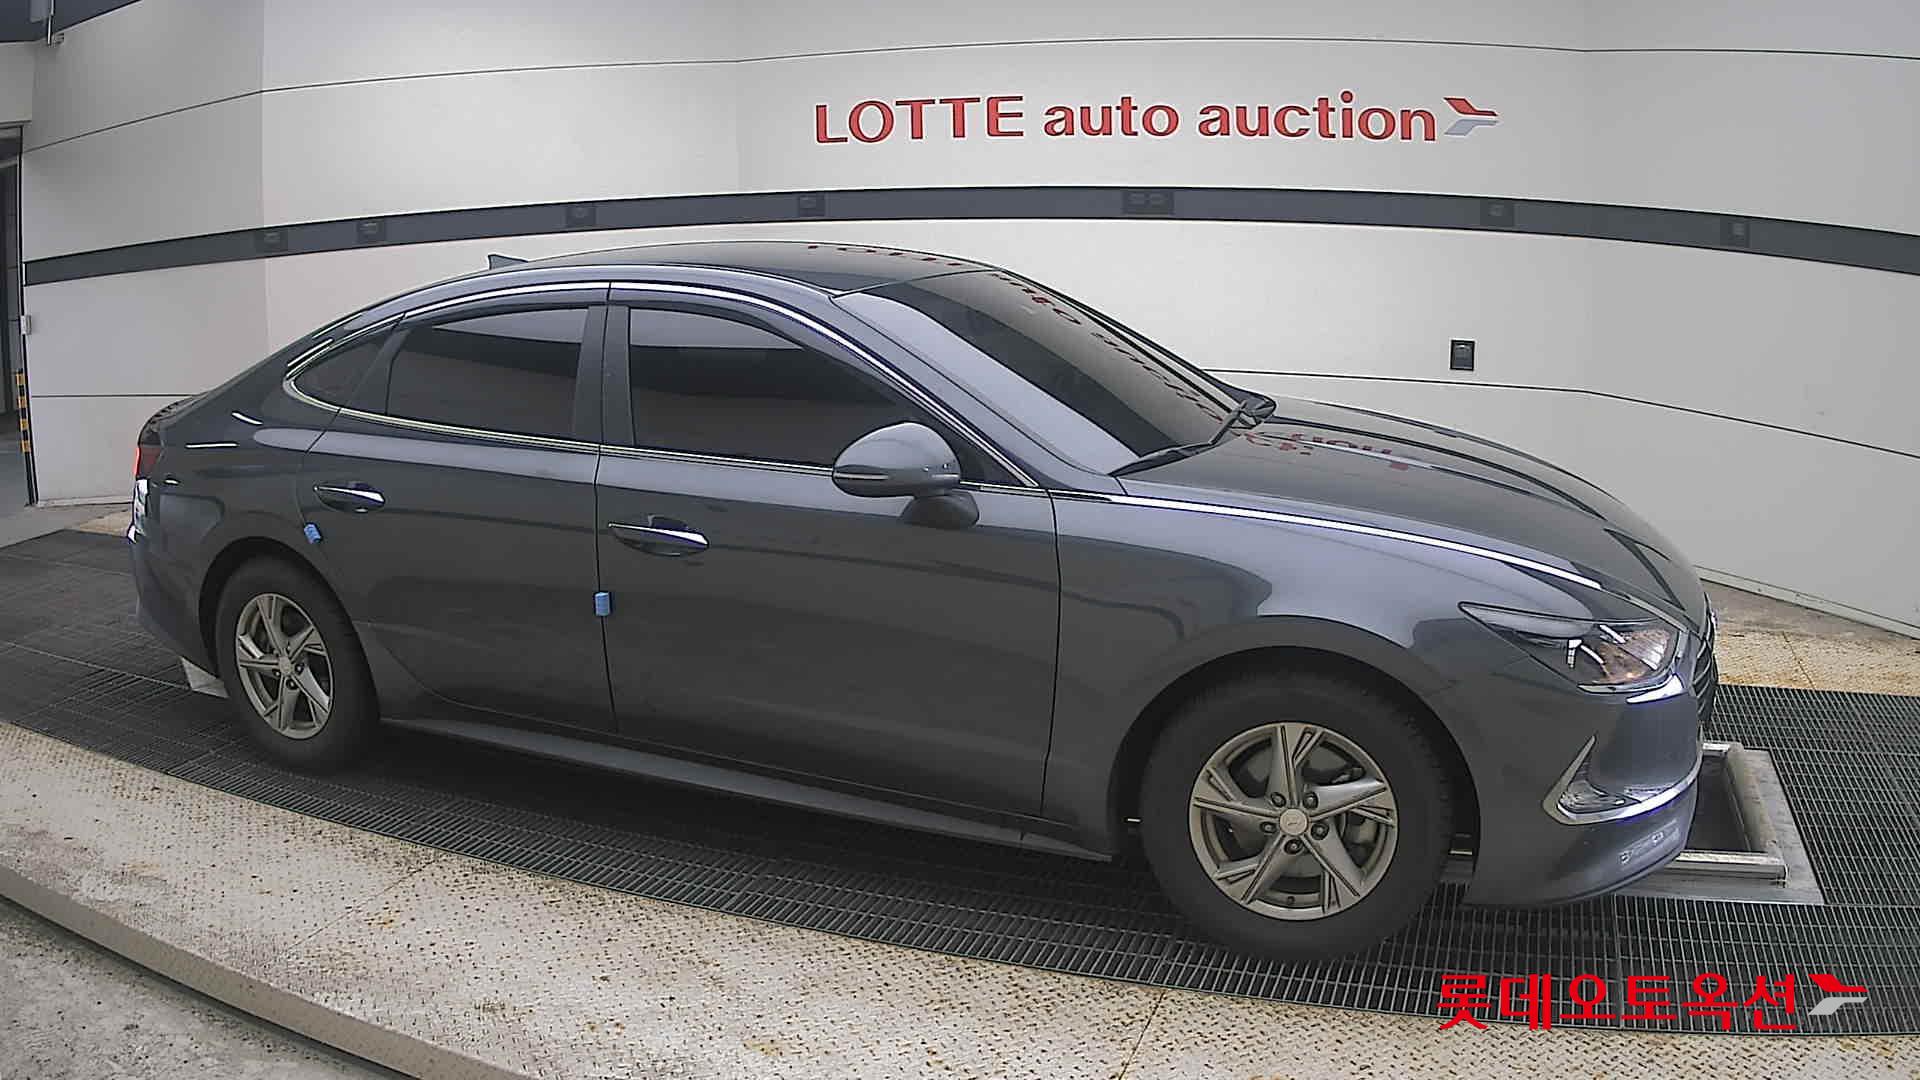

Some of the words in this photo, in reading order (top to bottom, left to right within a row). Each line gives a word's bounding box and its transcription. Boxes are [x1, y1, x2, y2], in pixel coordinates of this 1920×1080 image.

[815, 95, 1024, 143] LOTTE
[1043, 96, 1180, 137] auto
[1198, 90, 1436, 142] auction
